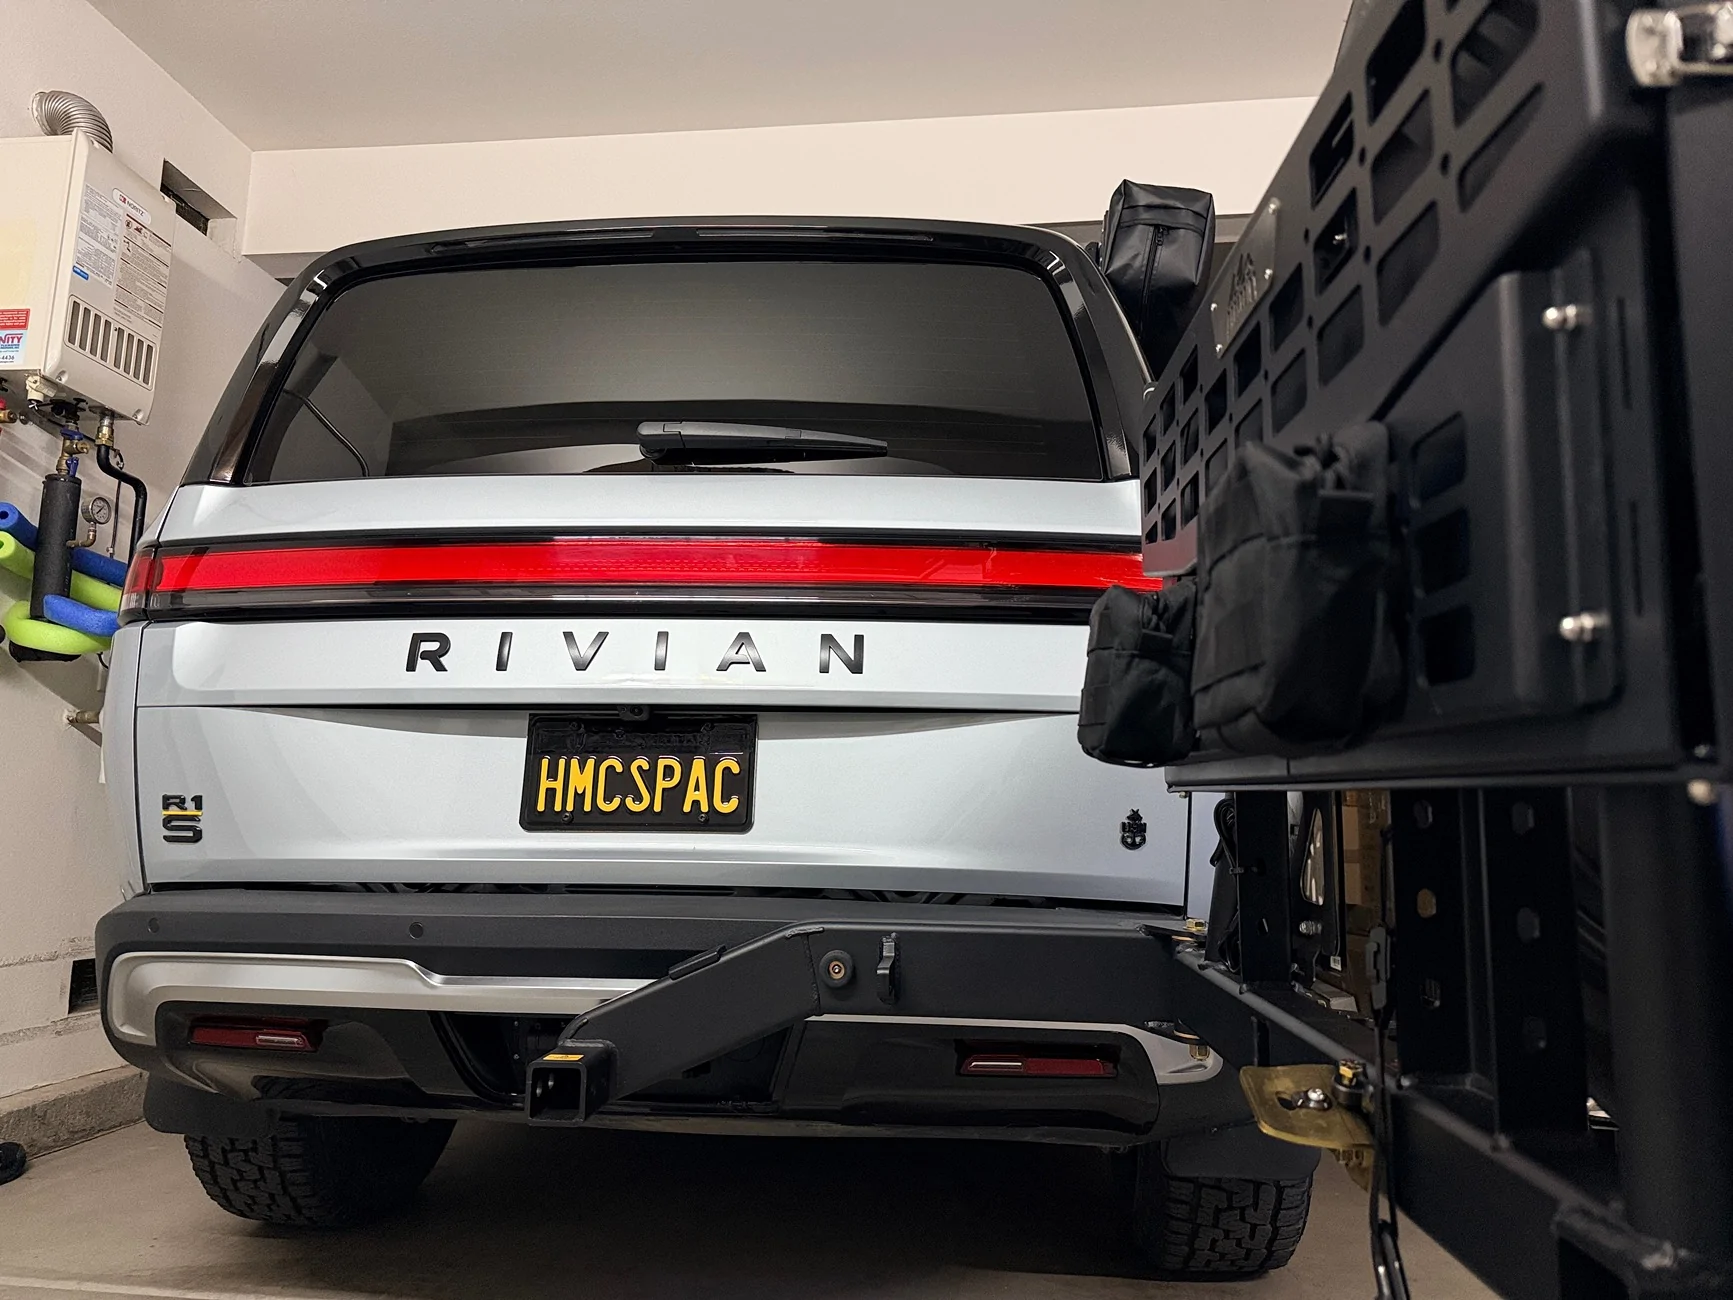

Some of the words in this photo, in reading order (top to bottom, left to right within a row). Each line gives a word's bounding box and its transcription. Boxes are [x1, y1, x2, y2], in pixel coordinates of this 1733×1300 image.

[126, 200, 144, 216] NORITZ
[405, 631, 865, 675] RIVIAN
[536, 755, 742, 814] HMCSPAC
[162, 794, 203, 811] R1
[162, 815, 203, 843] S
